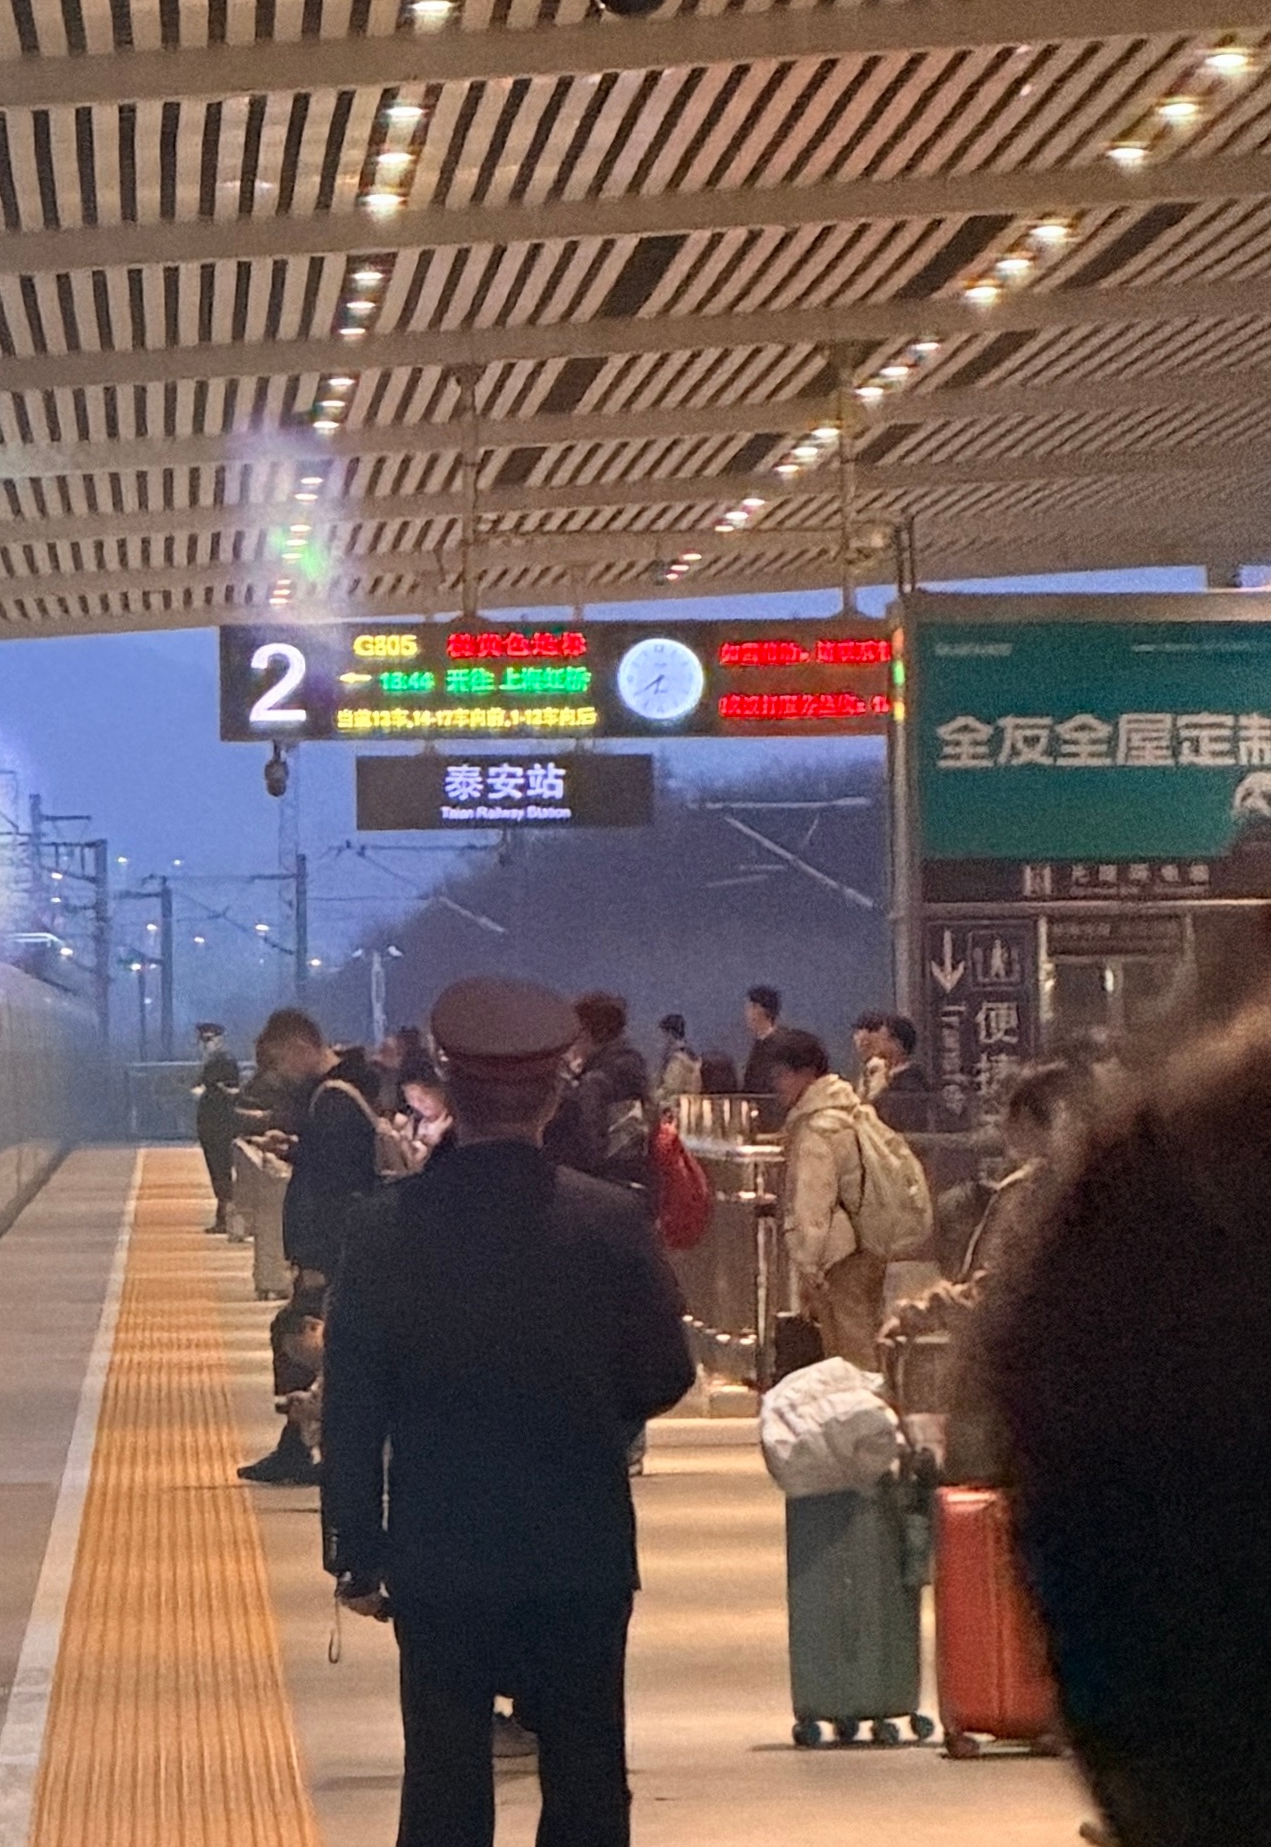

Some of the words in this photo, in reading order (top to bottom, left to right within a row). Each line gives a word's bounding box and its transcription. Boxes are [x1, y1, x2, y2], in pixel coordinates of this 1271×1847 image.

[353, 634, 418, 657] G805
[250, 642, 307, 722] 2
[499, 665, 592, 693] 上海虹桥
[936, 713, 1271, 767] 全友全屋定制
[444, 762, 567, 801] 泰安站
[476, 805, 525, 821] Railway
[526, 805, 572, 819] Station
